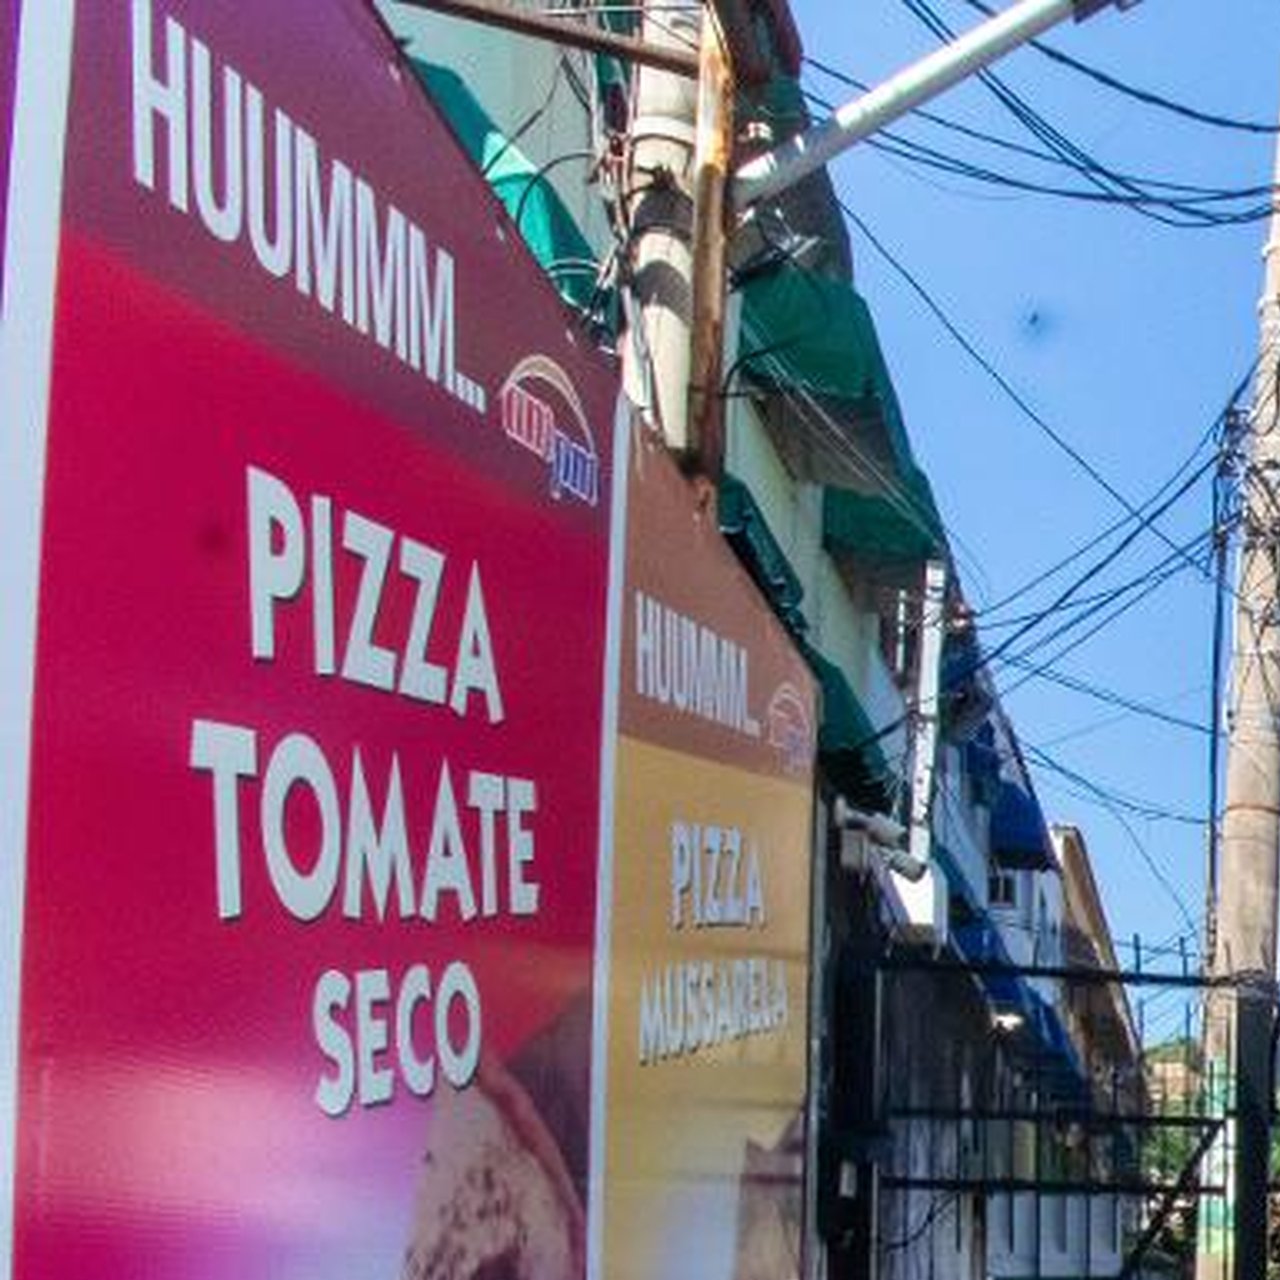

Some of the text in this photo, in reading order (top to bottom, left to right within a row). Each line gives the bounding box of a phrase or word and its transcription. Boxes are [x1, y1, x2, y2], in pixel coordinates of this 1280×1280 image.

[246, 464, 505, 725] PIZZA
[188, 718, 539, 924] TOMATE
[672, 820, 765, 930] PIZZA
[312, 960, 481, 1117] SECO
